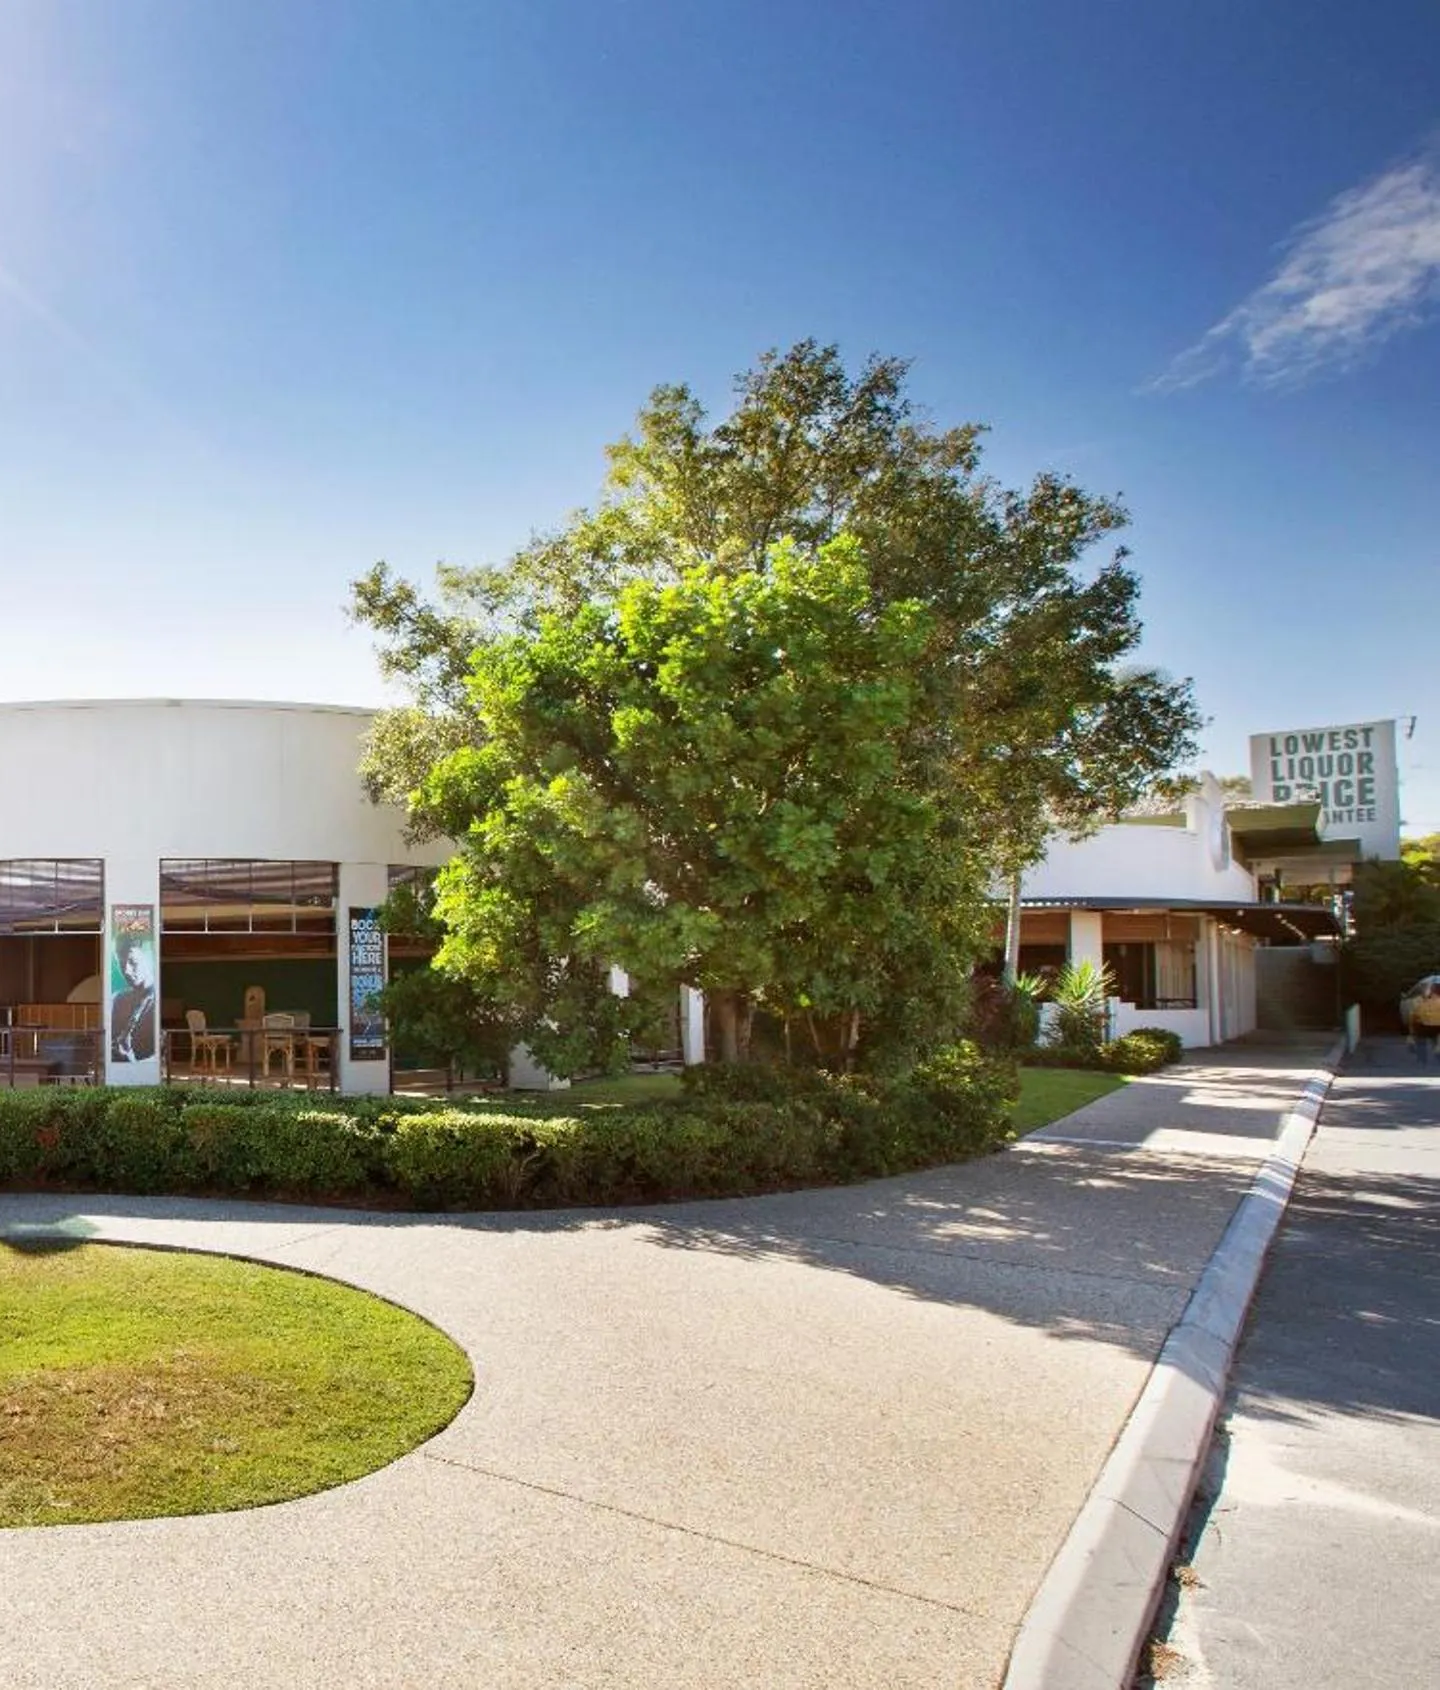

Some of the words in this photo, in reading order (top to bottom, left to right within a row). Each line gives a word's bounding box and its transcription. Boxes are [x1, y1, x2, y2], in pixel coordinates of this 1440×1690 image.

[1269, 727, 1375, 758] LOWEST
[1271, 752, 1375, 782] LIQUOR
[352, 930, 382, 944] YOUR
[352, 951, 382, 965] HERE
